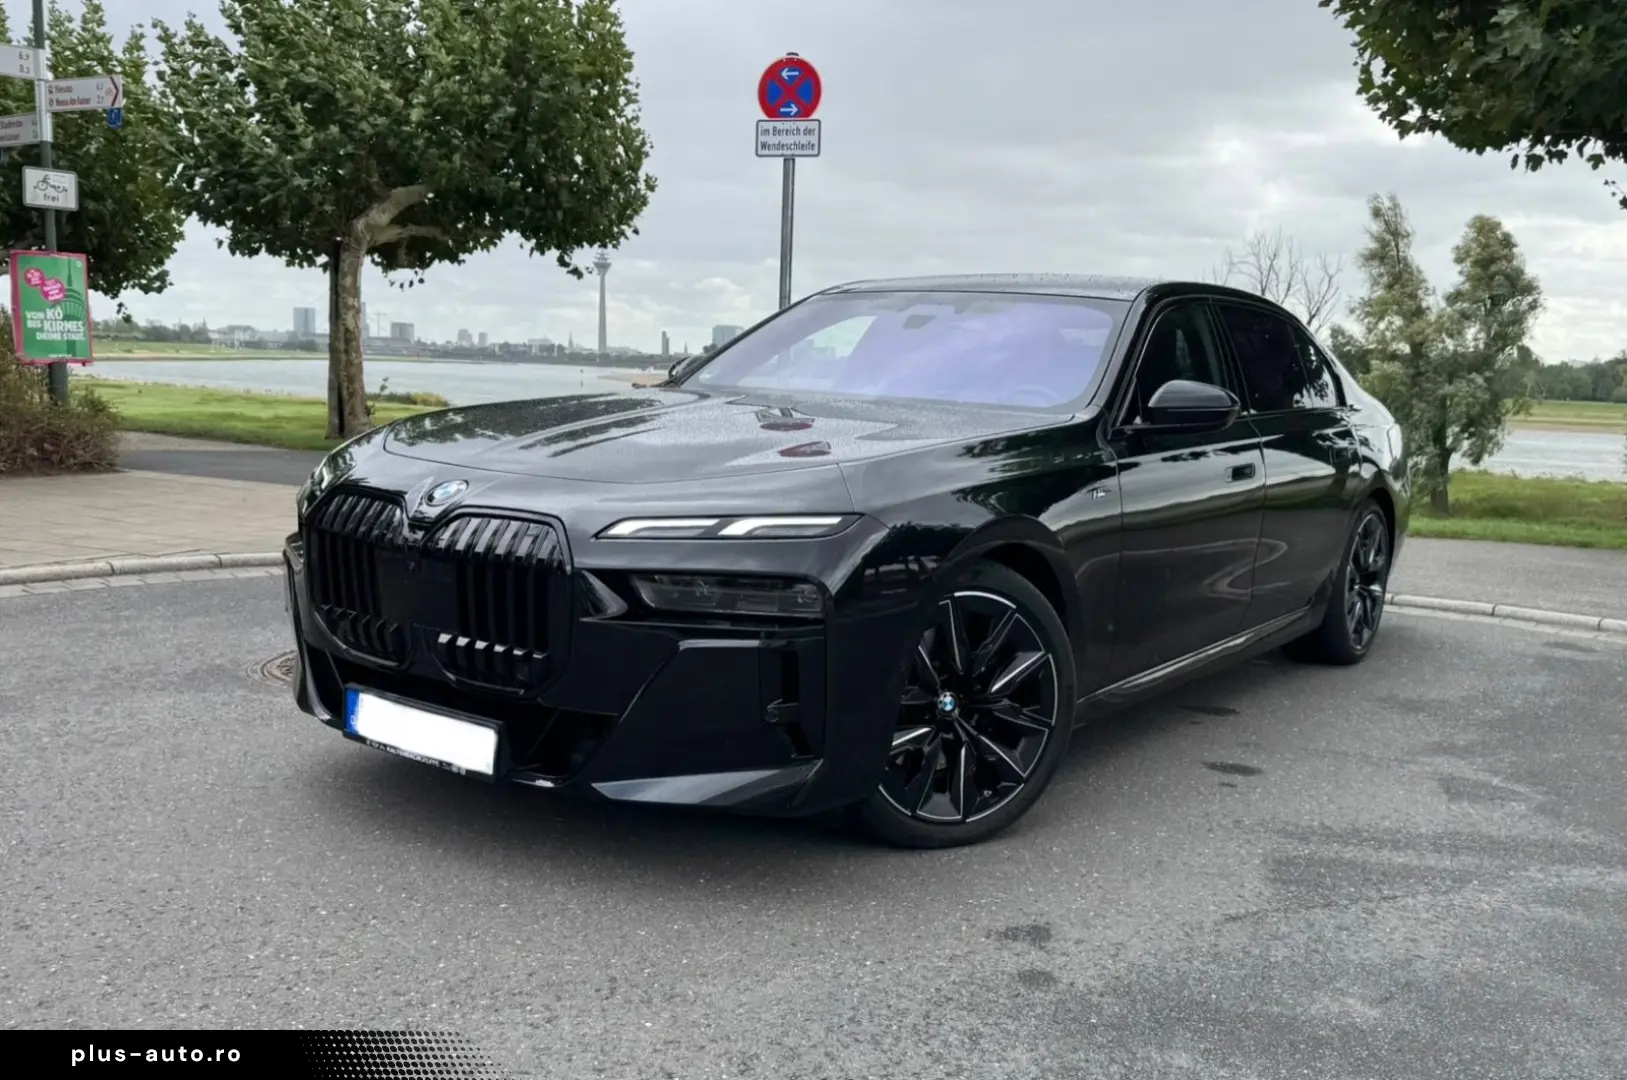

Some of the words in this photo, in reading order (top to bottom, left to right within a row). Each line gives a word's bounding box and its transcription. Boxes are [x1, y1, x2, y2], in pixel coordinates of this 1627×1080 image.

[760, 126, 770, 136] im
[772, 126, 801, 136] Bereich
[802, 126, 816, 136] der
[760, 140, 816, 151] Wendeschleife
[43, 193, 60, 202] frei
[25, 311, 44, 319] VON
[45, 305, 63, 319] KÖ
[43, 320, 85, 332] KIRMES
